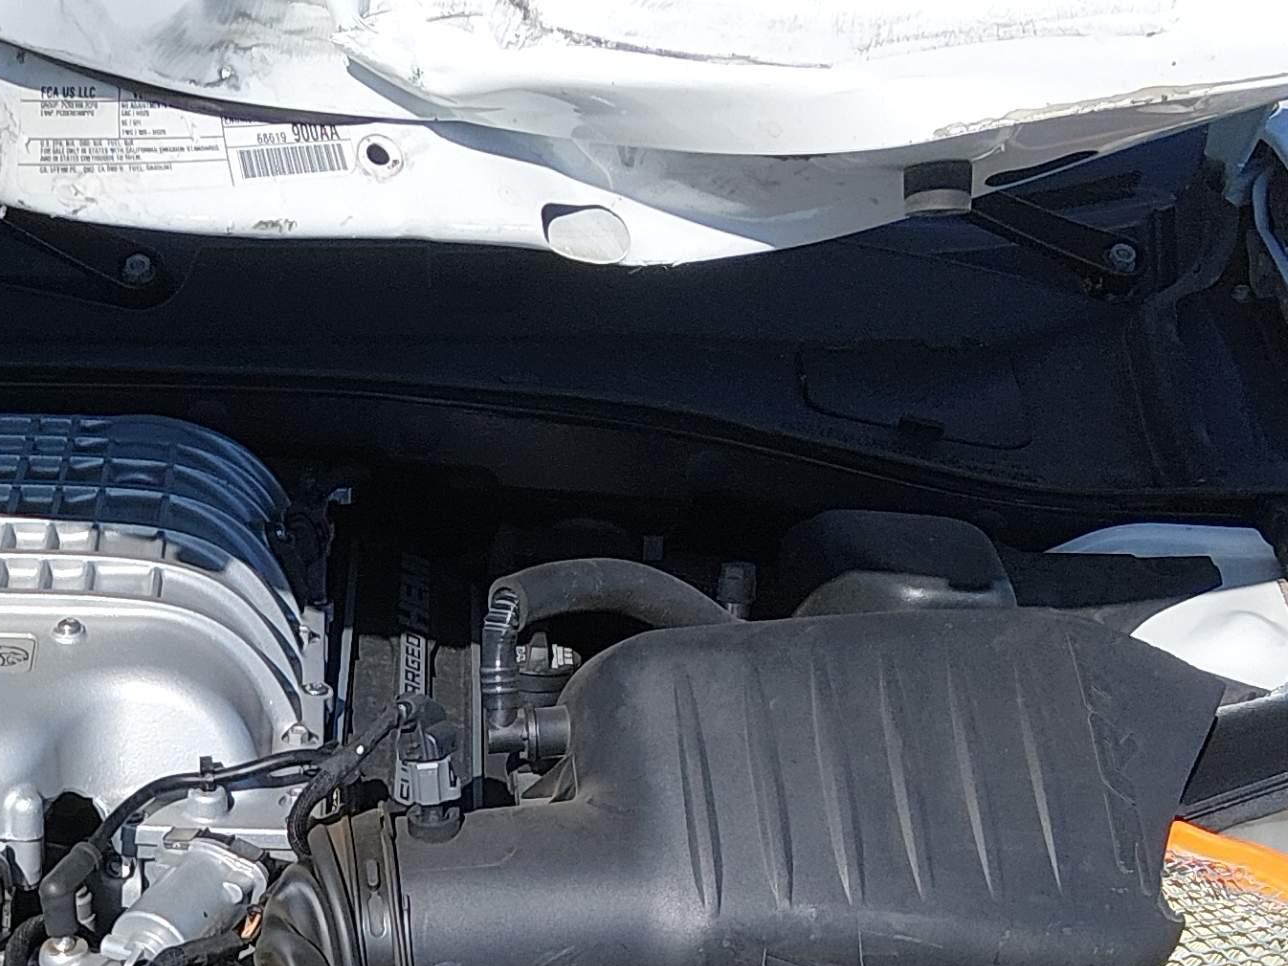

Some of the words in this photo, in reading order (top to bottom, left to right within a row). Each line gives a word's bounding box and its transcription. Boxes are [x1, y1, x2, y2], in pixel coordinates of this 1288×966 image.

[40, 86, 59, 99] FCA
[62, 86, 75, 99] US
[78, 86, 97, 99] LLC
